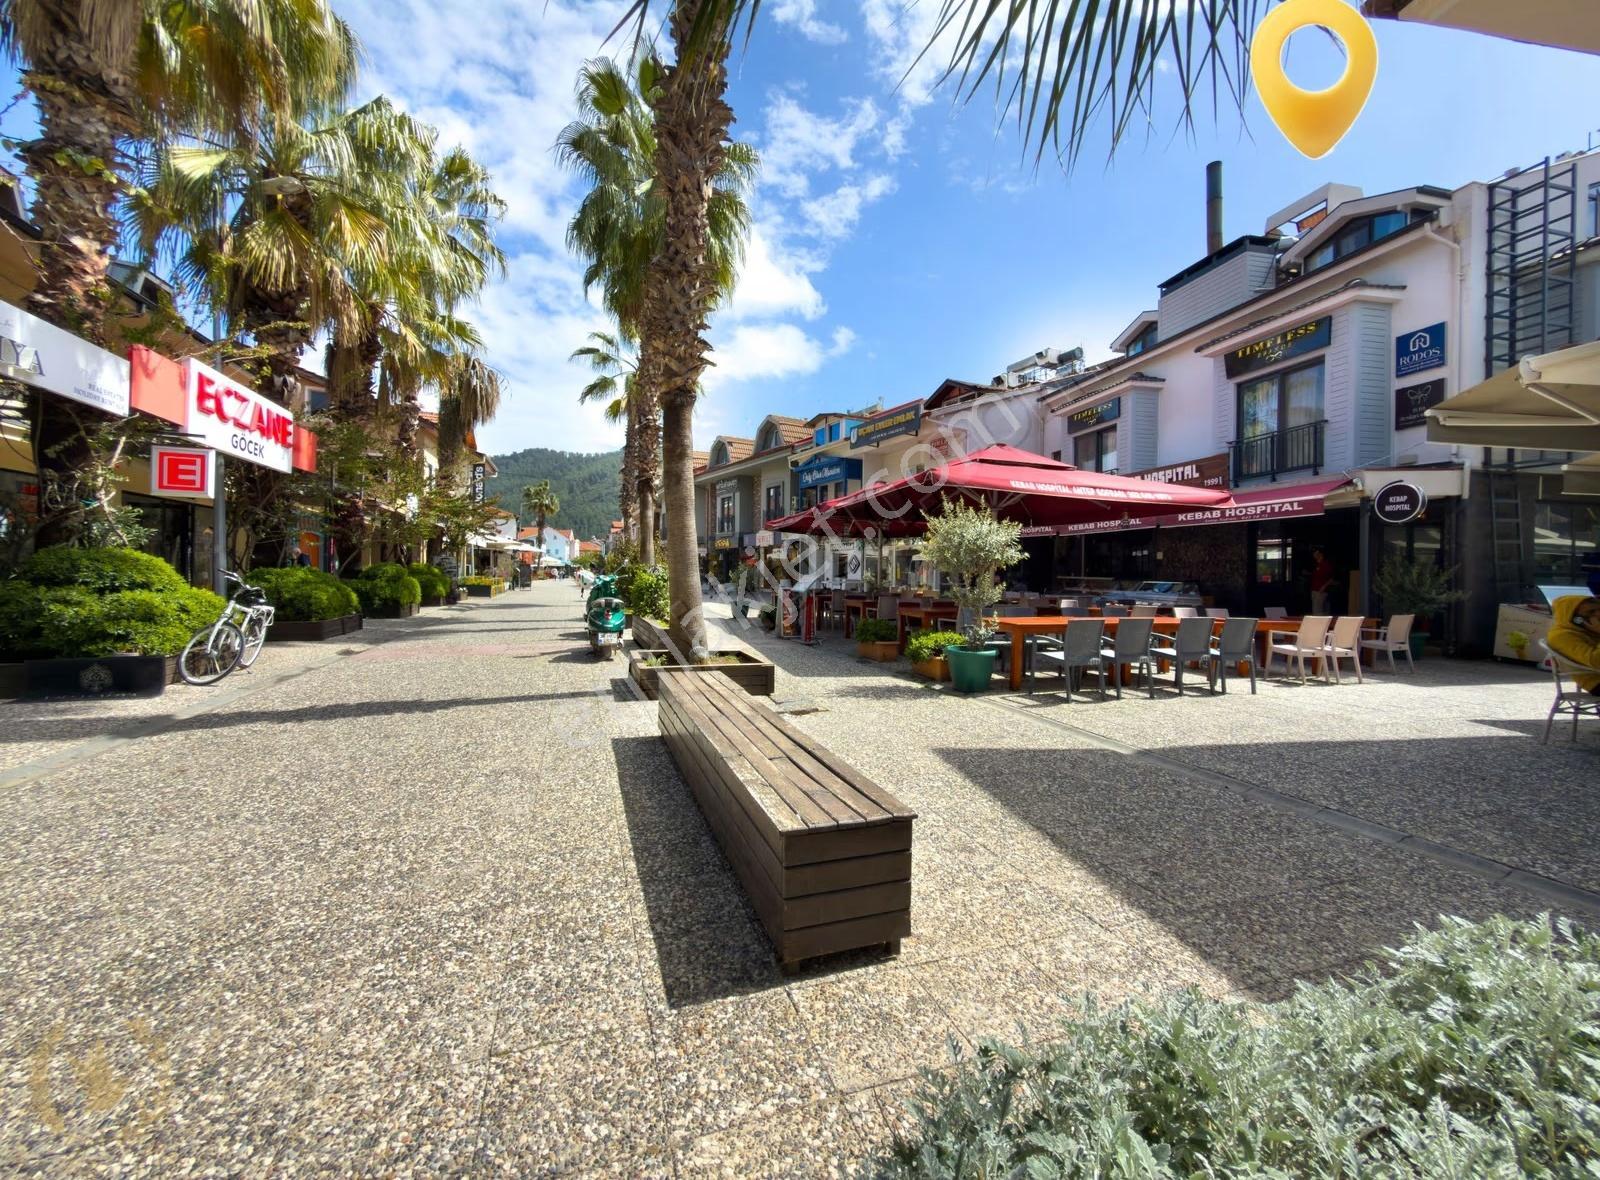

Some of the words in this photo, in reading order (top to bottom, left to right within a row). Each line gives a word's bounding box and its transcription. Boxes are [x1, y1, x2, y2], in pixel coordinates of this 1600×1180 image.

[0, 335, 45, 376] YA
[1400, 346, 1440, 366] RODOS
[197, 372, 293, 449] ECZANE
[231, 433, 265, 459] GÖCEK
[1144, 464, 1200, 483] HOSPITAL
[1178, 511, 1221, 522] KEBAB
[1225, 502, 1303, 517] HOSPITAL
[1385, 504, 1411, 512] HOSPITAL
[1068, 522, 1095, 532] KEBAB
[1097, 518, 1142, 530] HOSPAL
